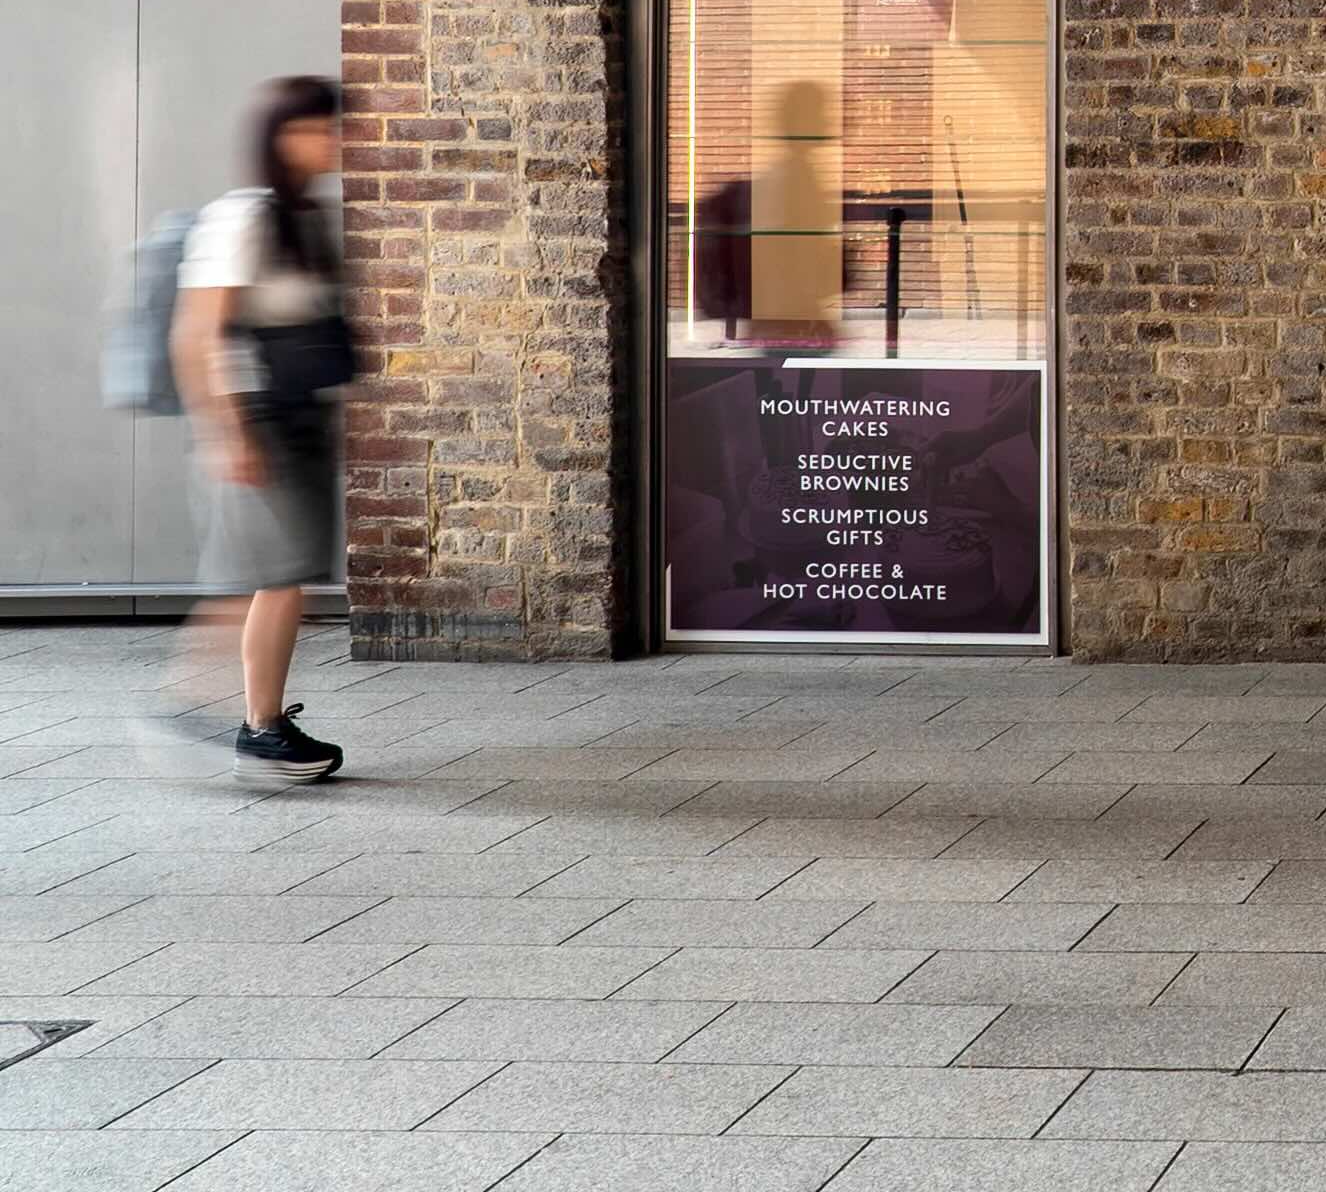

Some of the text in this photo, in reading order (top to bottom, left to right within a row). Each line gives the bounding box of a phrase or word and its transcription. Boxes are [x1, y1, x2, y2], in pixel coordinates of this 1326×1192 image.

[760, 399, 950, 417] MOUTHWATERING
[821, 420, 889, 437] CAKES
[797, 454, 912, 471] SEDUCTIVE
[800, 475, 910, 492] BROWNIES
[780, 508, 929, 525] SCRUMPTIOUS
[826, 530, 884, 546] GIFTS
[805, 563, 904, 579] COFFEE &
[763, 583, 948, 601] HOT CHOCOLATE
